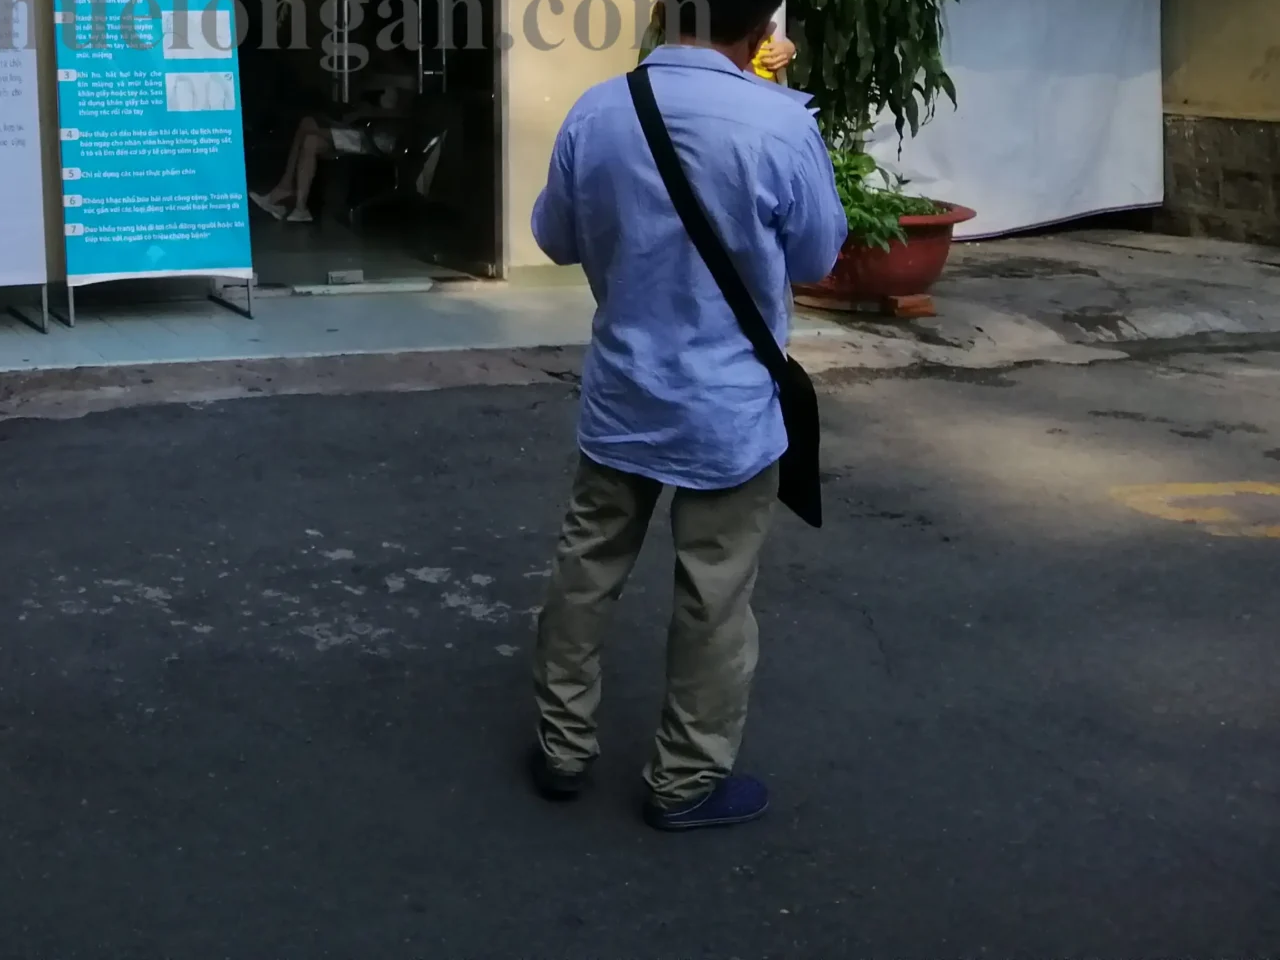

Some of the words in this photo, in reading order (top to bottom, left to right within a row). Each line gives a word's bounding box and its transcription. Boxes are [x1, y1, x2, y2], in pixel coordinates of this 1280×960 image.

[63, 71, 70, 80] 3
[66, 130, 73, 139] 4
[69, 196, 76, 205] 6
[70, 225, 77, 234] 7
